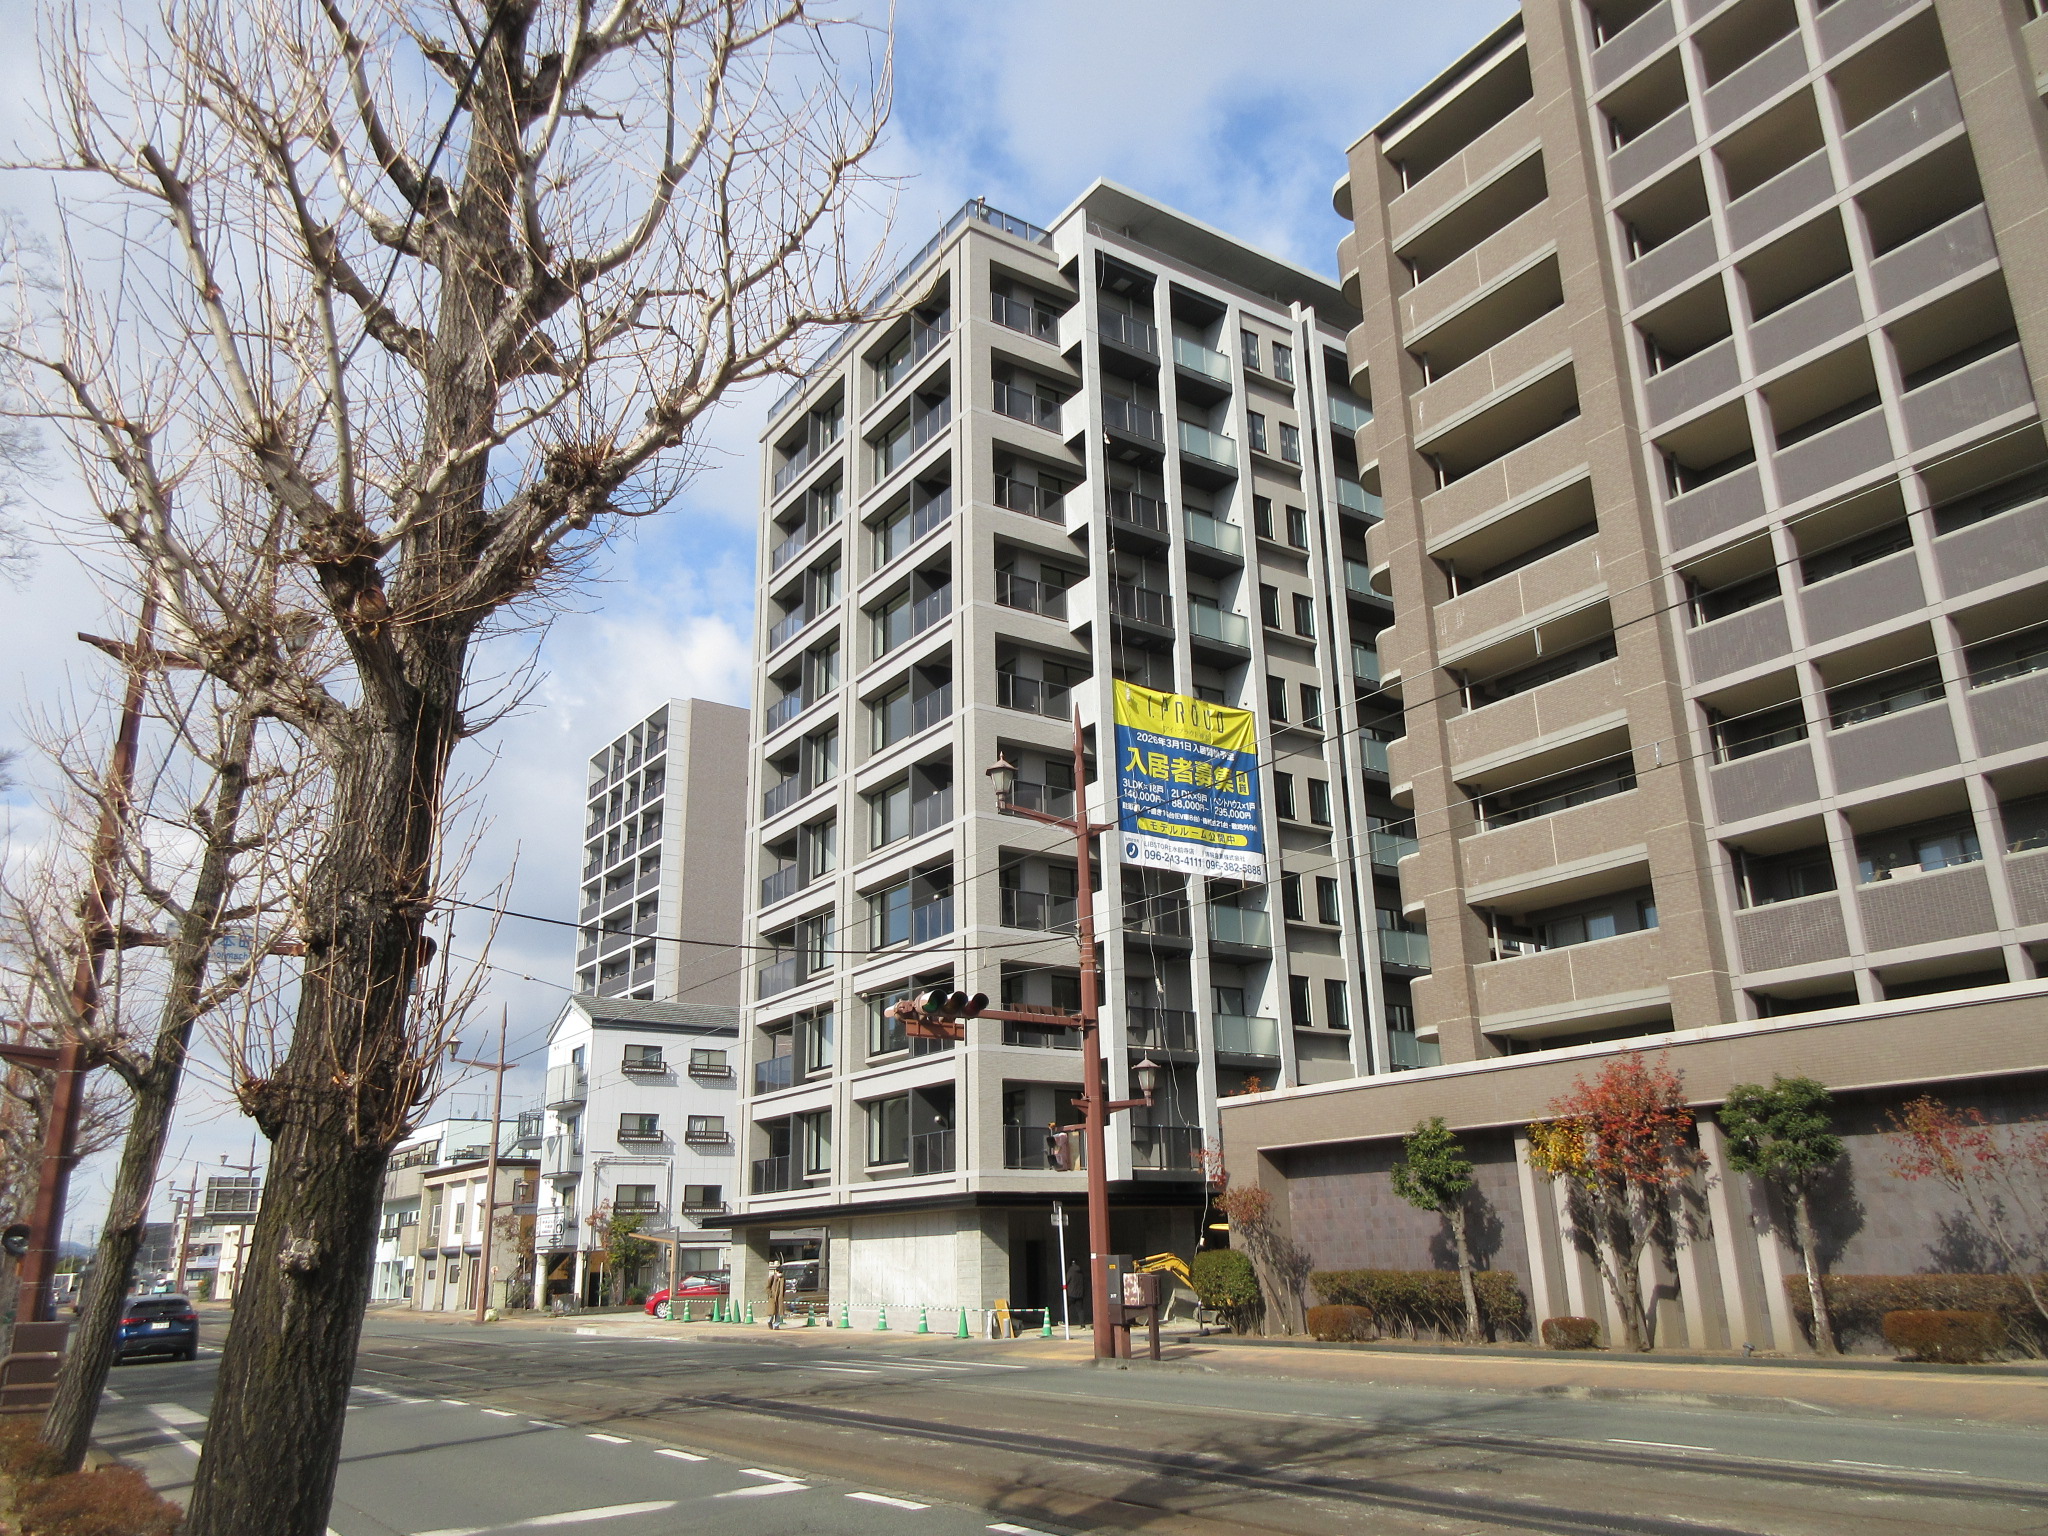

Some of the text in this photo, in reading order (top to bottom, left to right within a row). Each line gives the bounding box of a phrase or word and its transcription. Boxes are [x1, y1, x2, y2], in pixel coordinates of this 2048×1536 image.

[1124, 746, 1235, 794] 入居者募集
